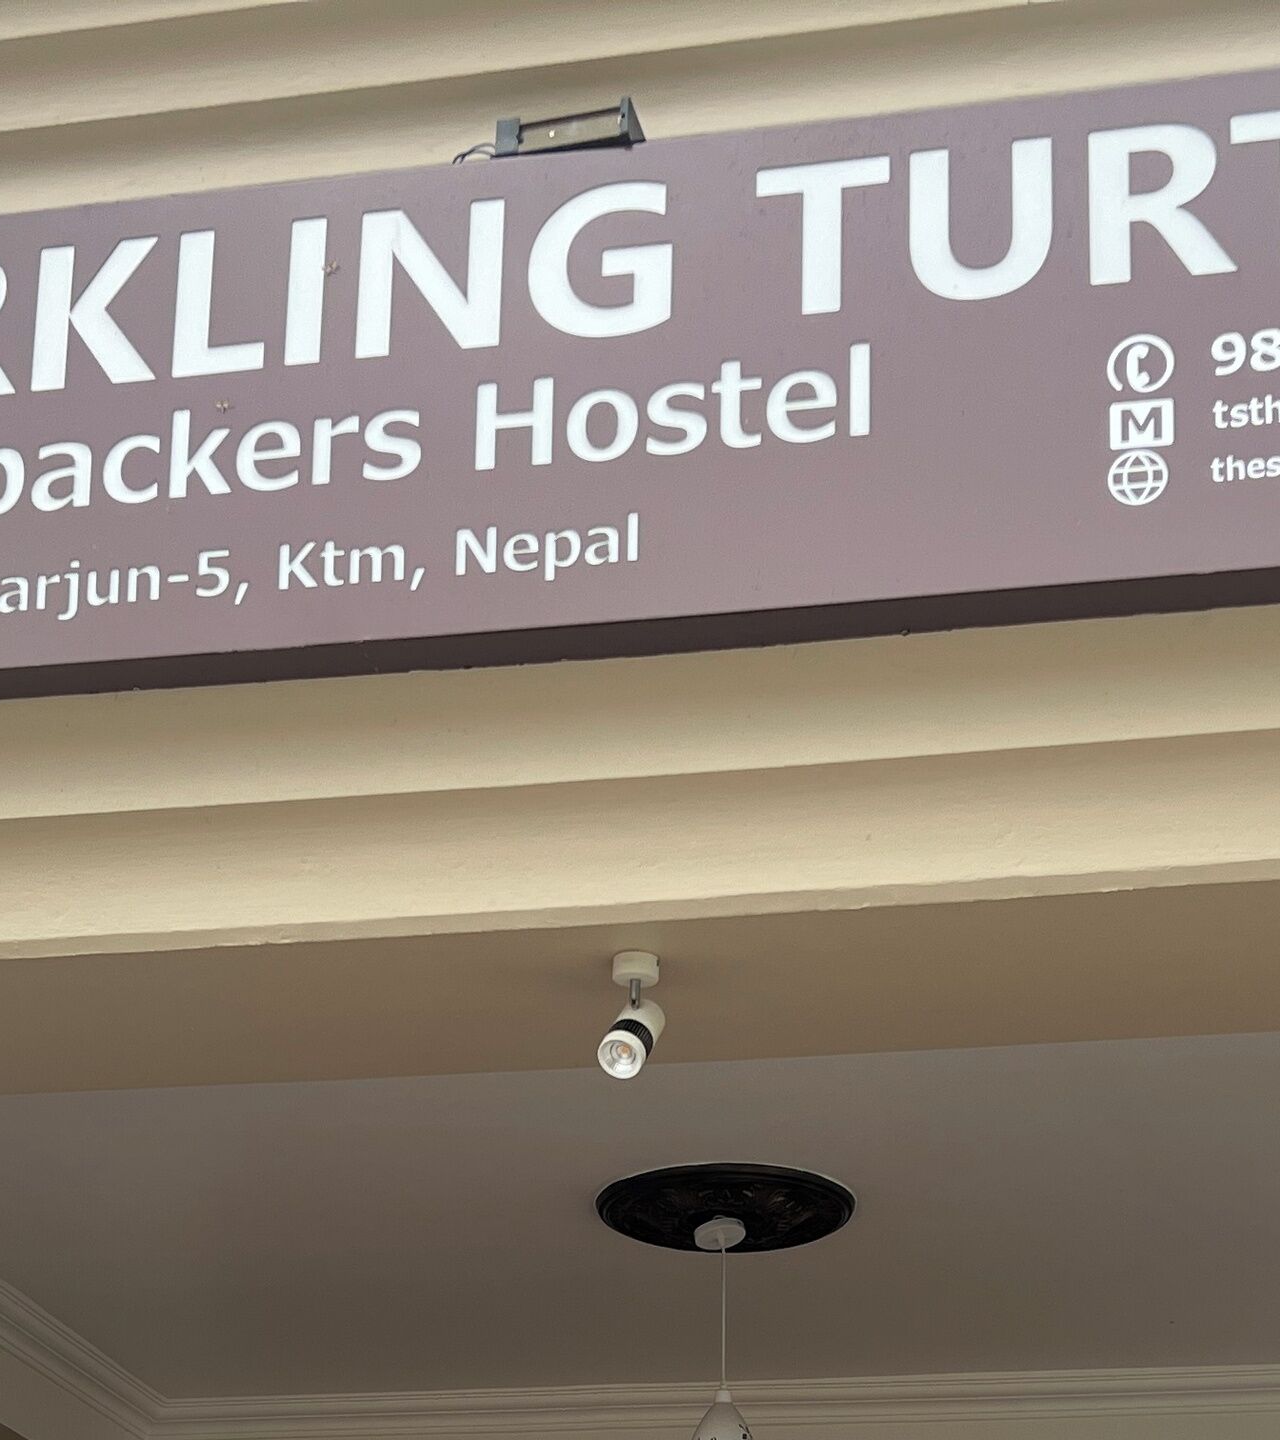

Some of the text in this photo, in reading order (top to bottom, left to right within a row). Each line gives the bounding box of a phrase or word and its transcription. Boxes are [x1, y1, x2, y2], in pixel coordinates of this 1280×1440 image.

[473, 342, 872, 472] Hostel
[276, 540, 427, 592] Ktm,
[454, 511, 641, 582] Nepal
